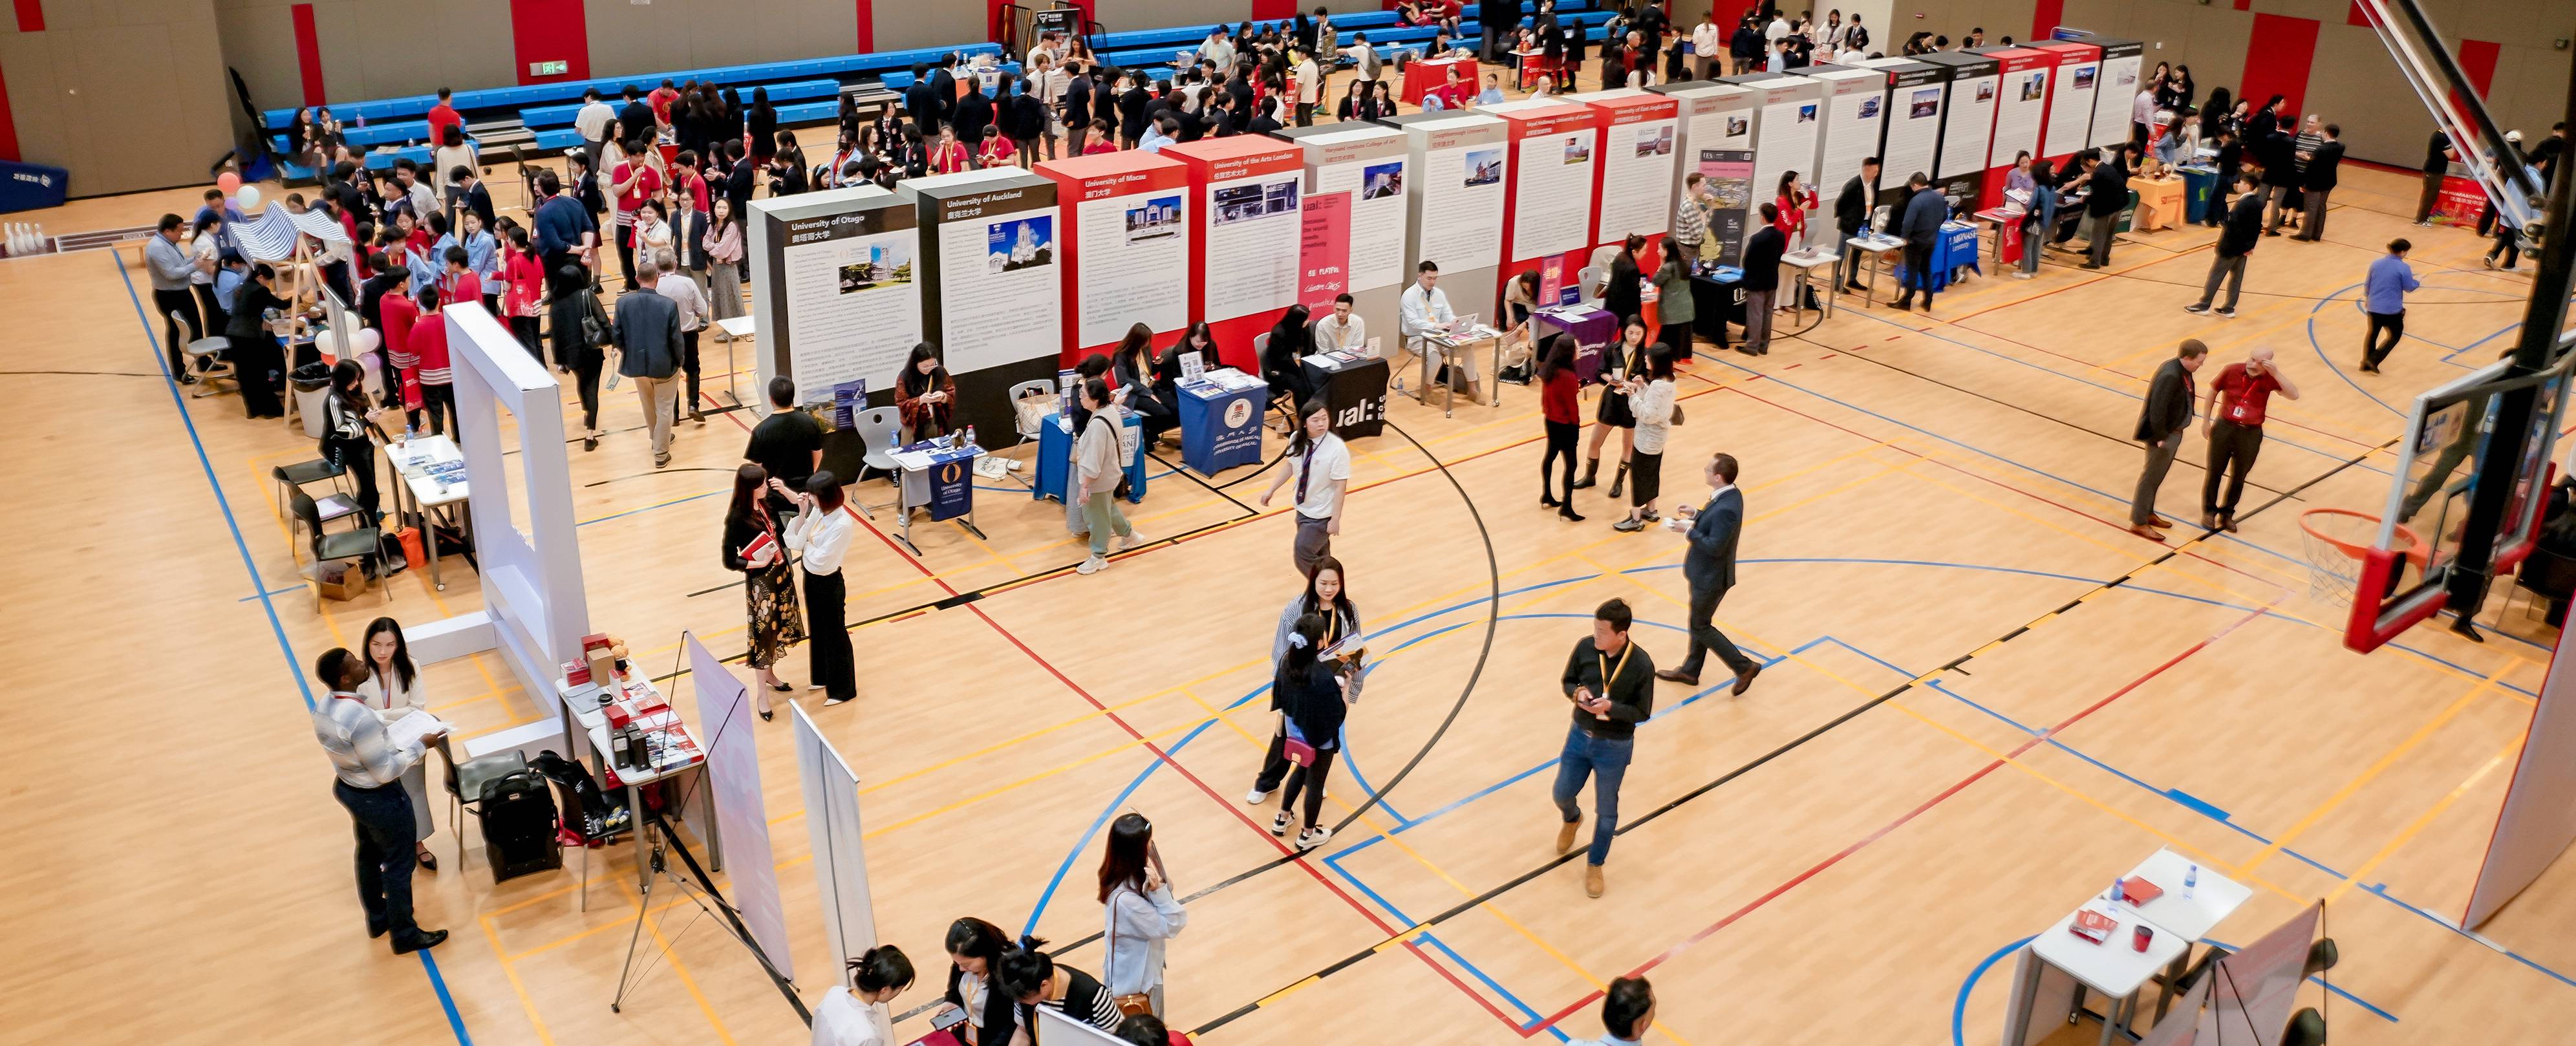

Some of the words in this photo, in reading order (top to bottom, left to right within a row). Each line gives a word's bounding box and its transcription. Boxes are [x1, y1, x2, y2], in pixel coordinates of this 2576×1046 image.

[1432, 131, 1466, 140] Loughborough
[1214, 159, 1241, 170] University
[1273, 153, 1293, 162] London
[1086, 178, 1117, 187] University
[947, 198, 982, 208] University
[991, 190, 1022, 201] Auckland
[1085, 189, 1111, 198] 澳门大学
[1304, 200, 1322, 211] ual:
[791, 219, 830, 231] University
[832, 217, 839, 226] of
[841, 215, 864, 225] Otago
[792, 230, 830, 243] 奥塔哥大学
[941, 483, 962, 491] University
